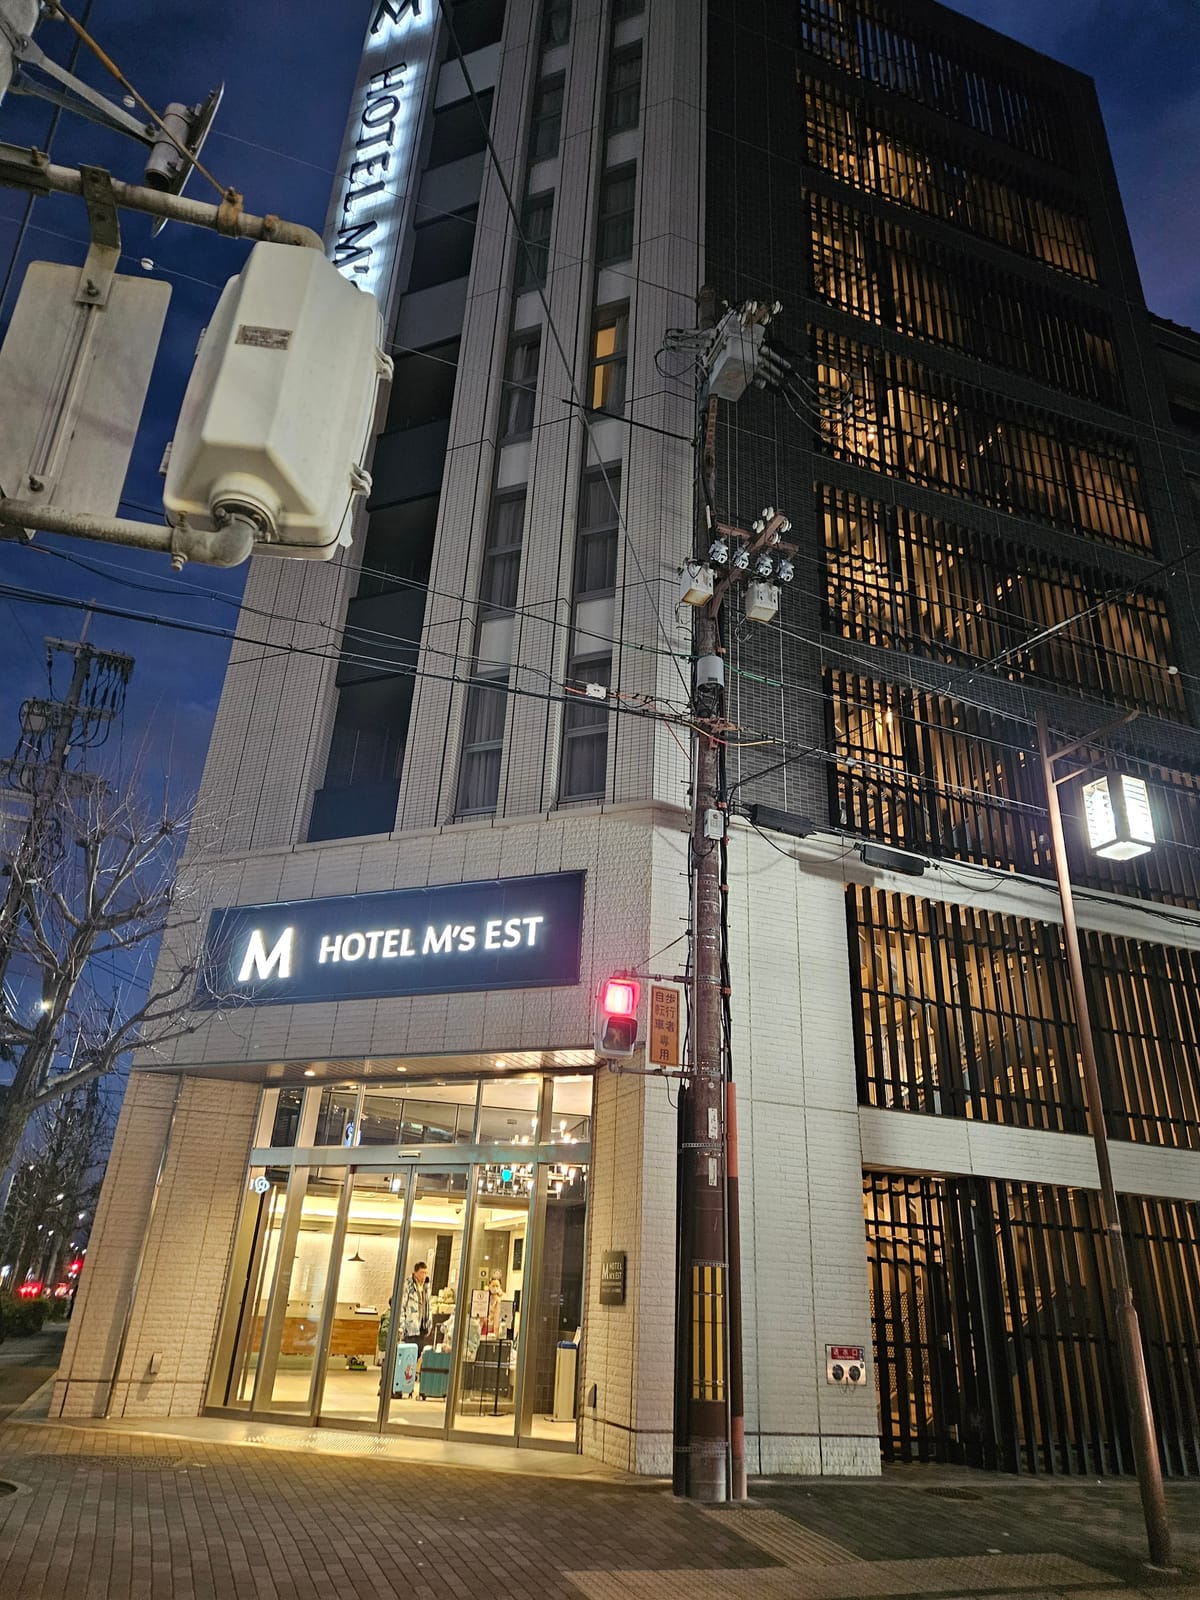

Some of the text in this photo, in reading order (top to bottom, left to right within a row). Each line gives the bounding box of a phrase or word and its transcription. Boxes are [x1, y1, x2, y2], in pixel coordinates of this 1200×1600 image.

[344, 62, 407, 213] HOTEL
[238, 927, 294, 981] M
[319, 928, 415, 963] HOTEL
[485, 916, 544, 949] EST
[655, 991, 665, 1030] 自転車
[665, 992, 676, 1032] 歩行者
[659, 1034, 669, 1060] 専用
